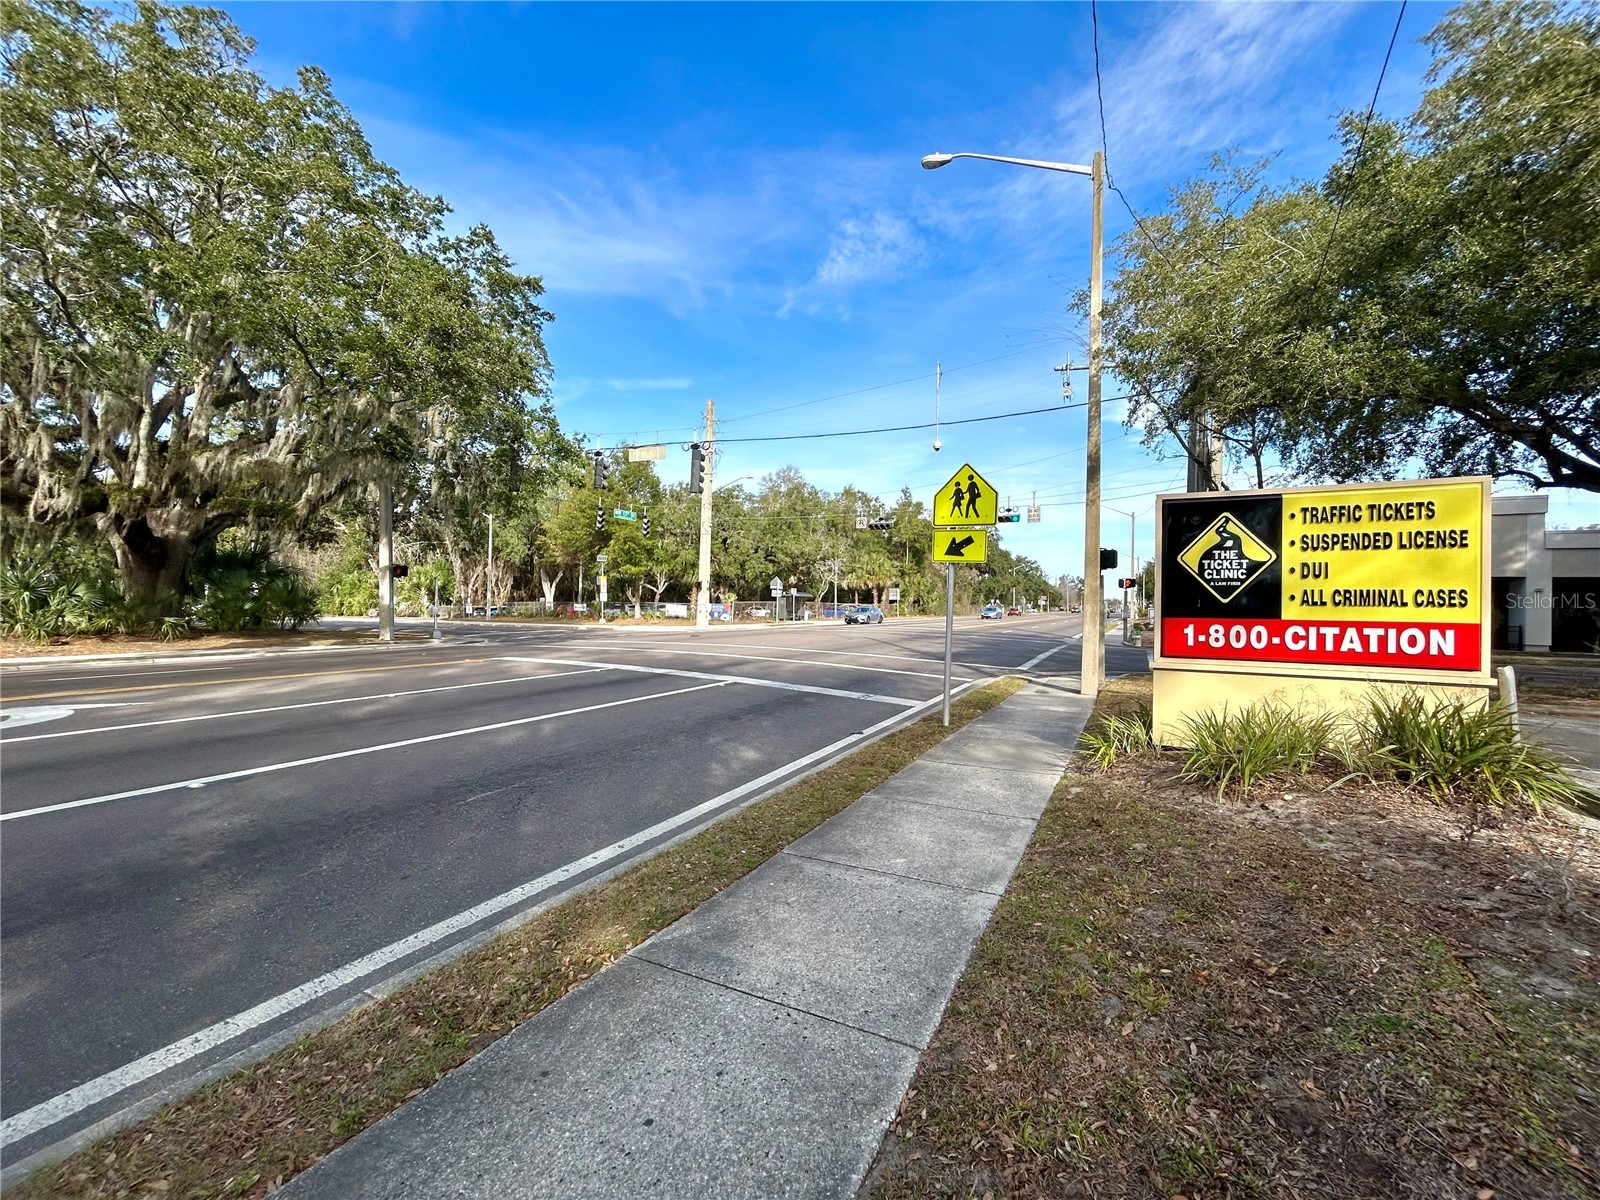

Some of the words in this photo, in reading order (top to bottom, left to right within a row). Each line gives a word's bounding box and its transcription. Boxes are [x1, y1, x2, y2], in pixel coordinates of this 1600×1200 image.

[1301, 504, 1362, 524] TRAFFIC
[1368, 501, 1436, 522] TICKETS
[1301, 532, 1393, 552] SUSPENDED
[1399, 530, 1469, 550] LICENSE
[1213, 550, 1239, 560] THE
[1202, 560, 1249, 570] TICKET
[1301, 562, 1329, 580] DUI
[1204, 569, 1247, 580] CLINIC
[1301, 589, 1328, 607] ALL
[1333, 589, 1409, 608] CRIMINAL
[1415, 589, 1469, 608] CASES
[1183, 623, 1455, 656] 1-800-CITATION
